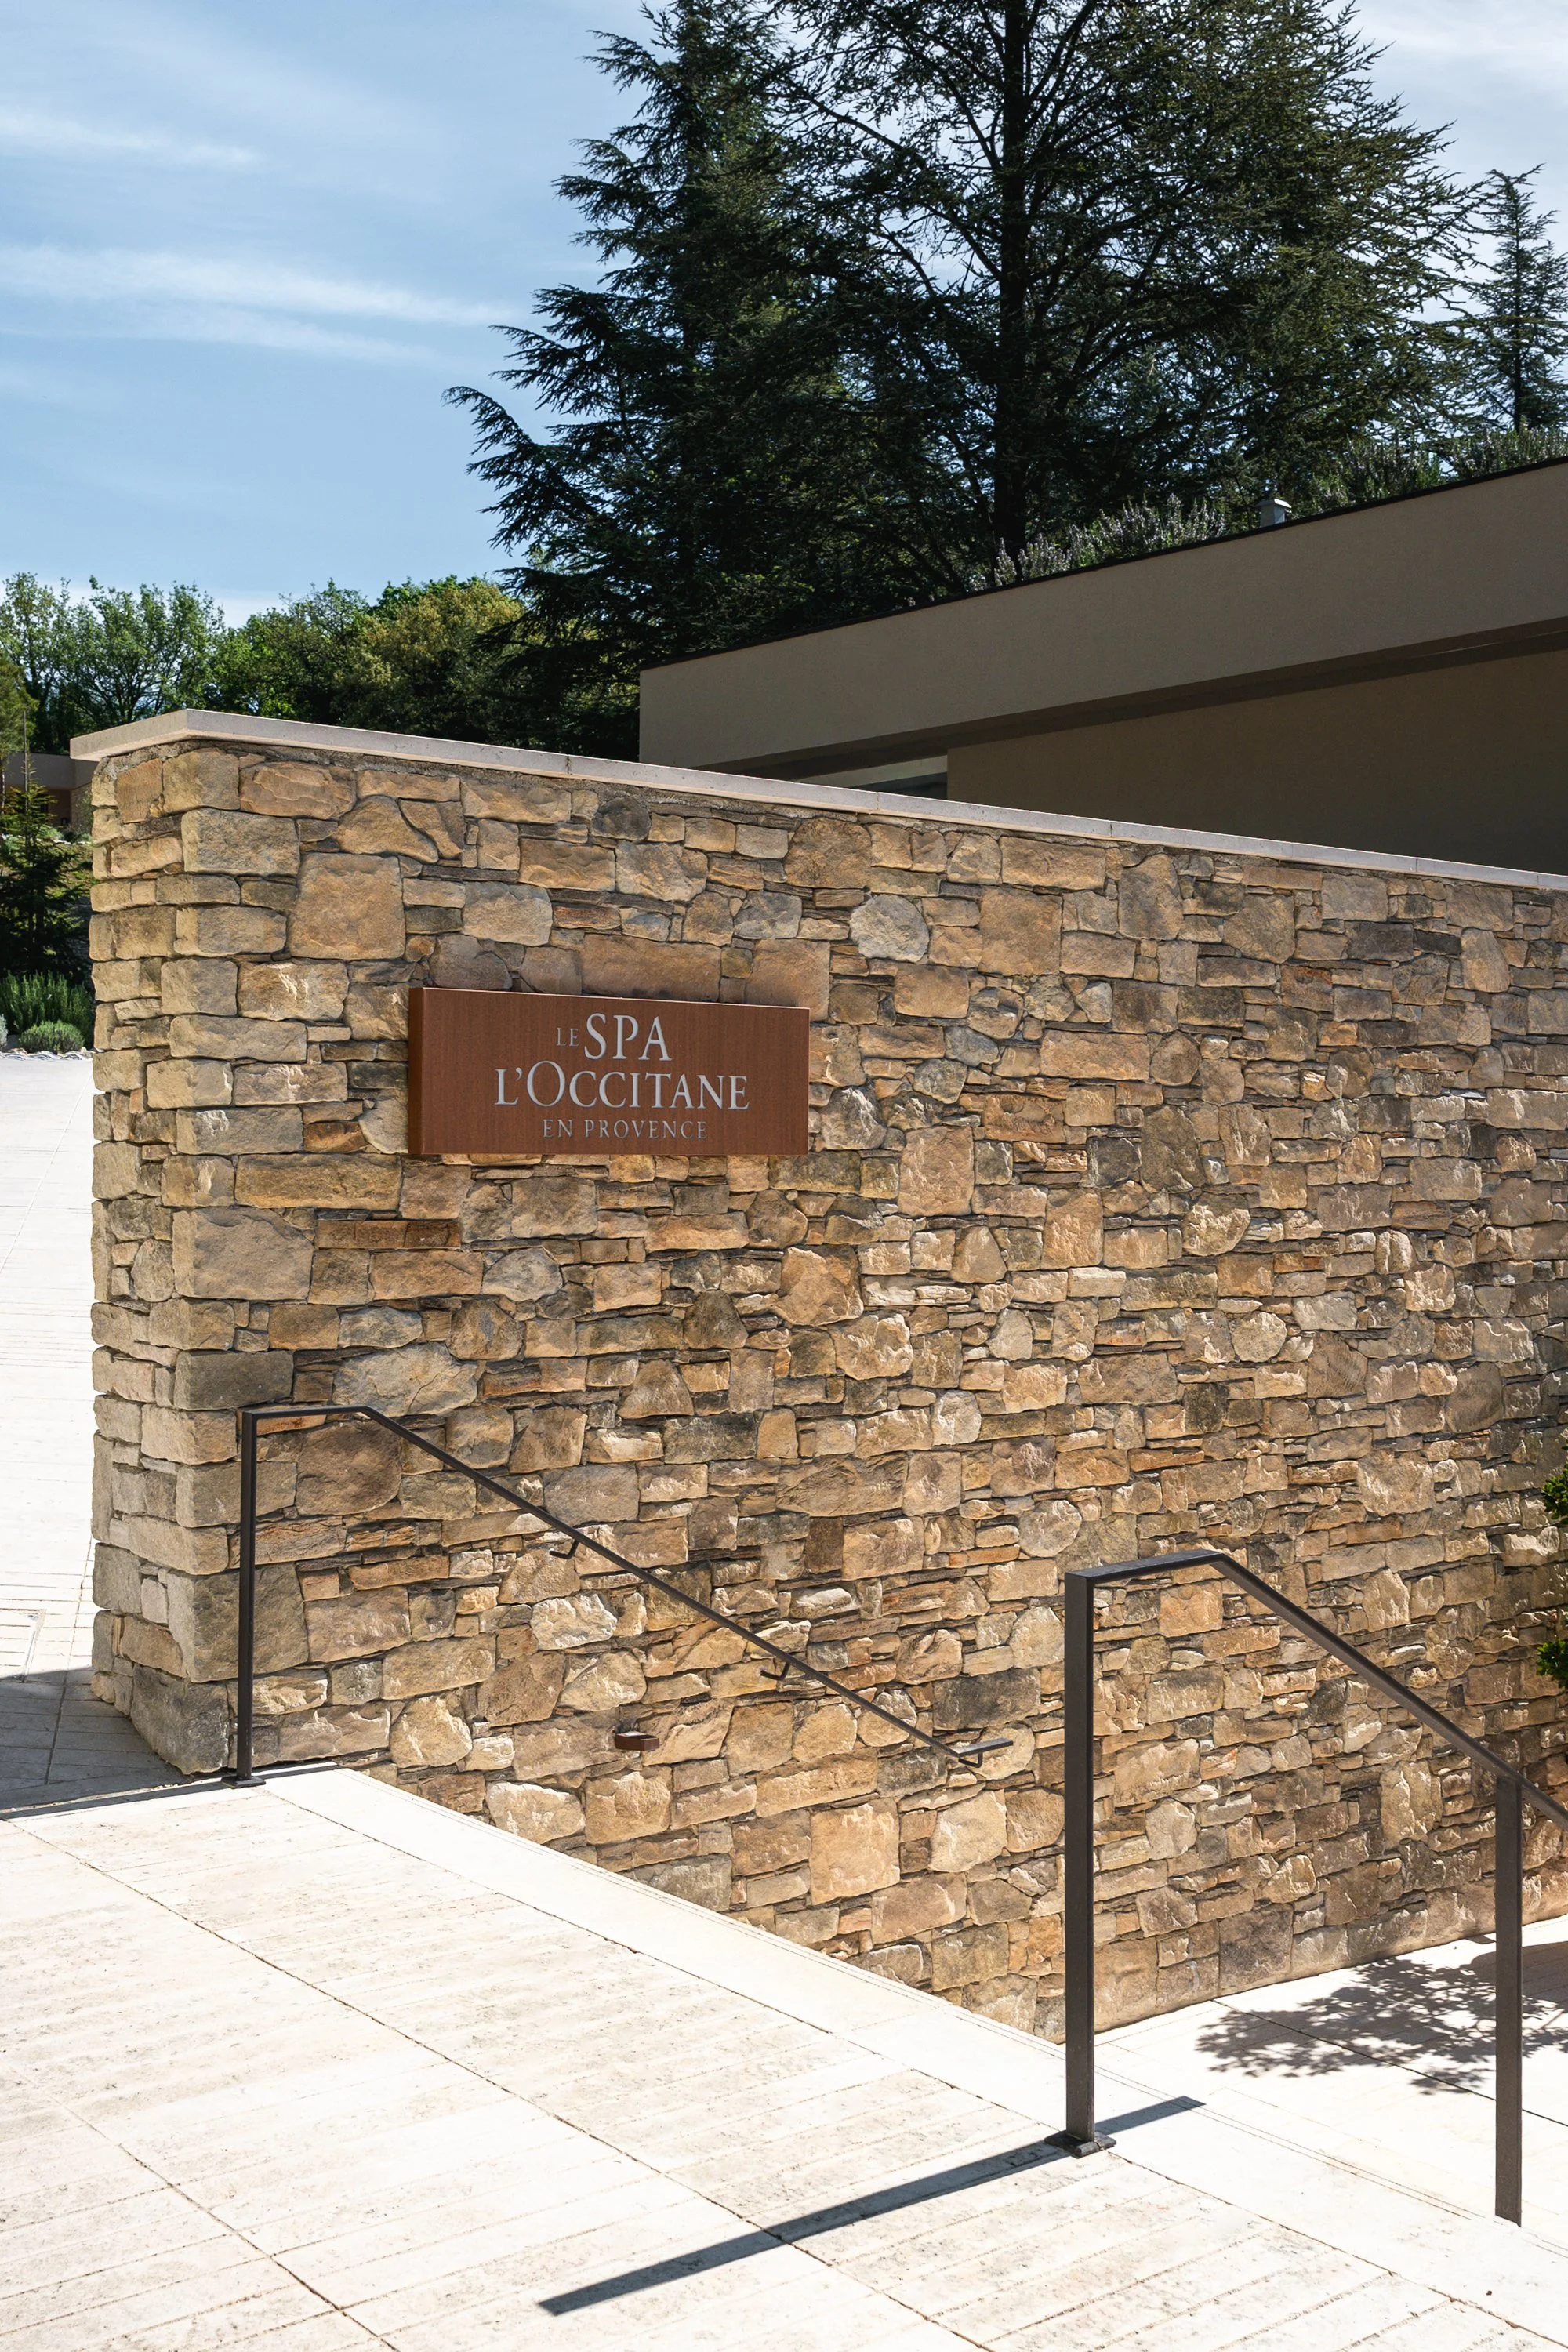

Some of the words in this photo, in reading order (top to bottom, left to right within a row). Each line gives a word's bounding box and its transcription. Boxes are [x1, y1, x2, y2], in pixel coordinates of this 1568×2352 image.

[557, 1026, 580, 1047] LE
[584, 1013, 673, 1061] SPA
[495, 1060, 750, 1110] L'OCCITANE
[543, 1119, 573, 1138] EN
[584, 1119, 707, 1139] PROVENCE
